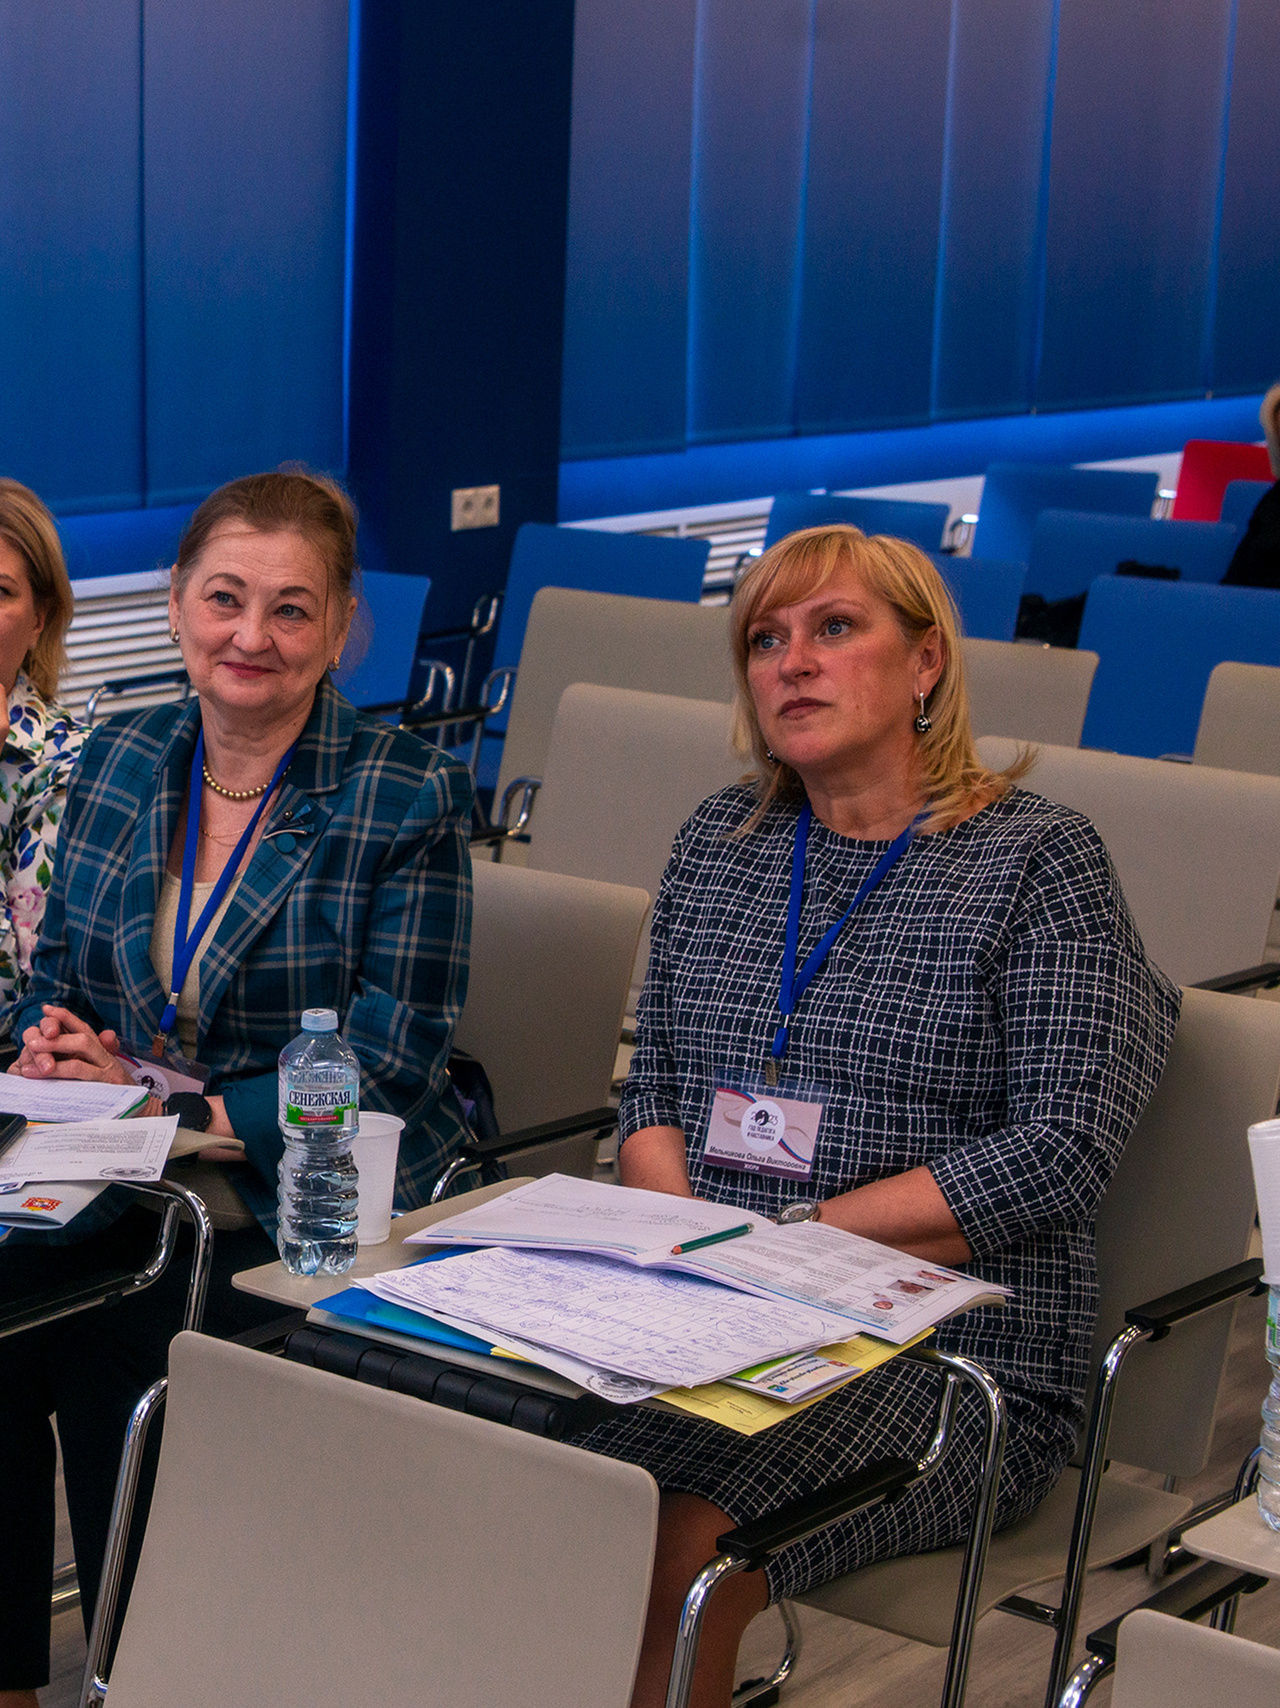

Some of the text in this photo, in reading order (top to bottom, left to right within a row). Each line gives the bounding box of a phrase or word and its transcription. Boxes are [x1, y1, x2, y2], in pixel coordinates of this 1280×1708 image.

[289, 1090, 351, 1106] СЕНЕЖСКАЯ
[709, 1146, 806, 1170] Мельникова Ольга Викторовна
[743, 1163, 760, 1171] ЖЮРИ
